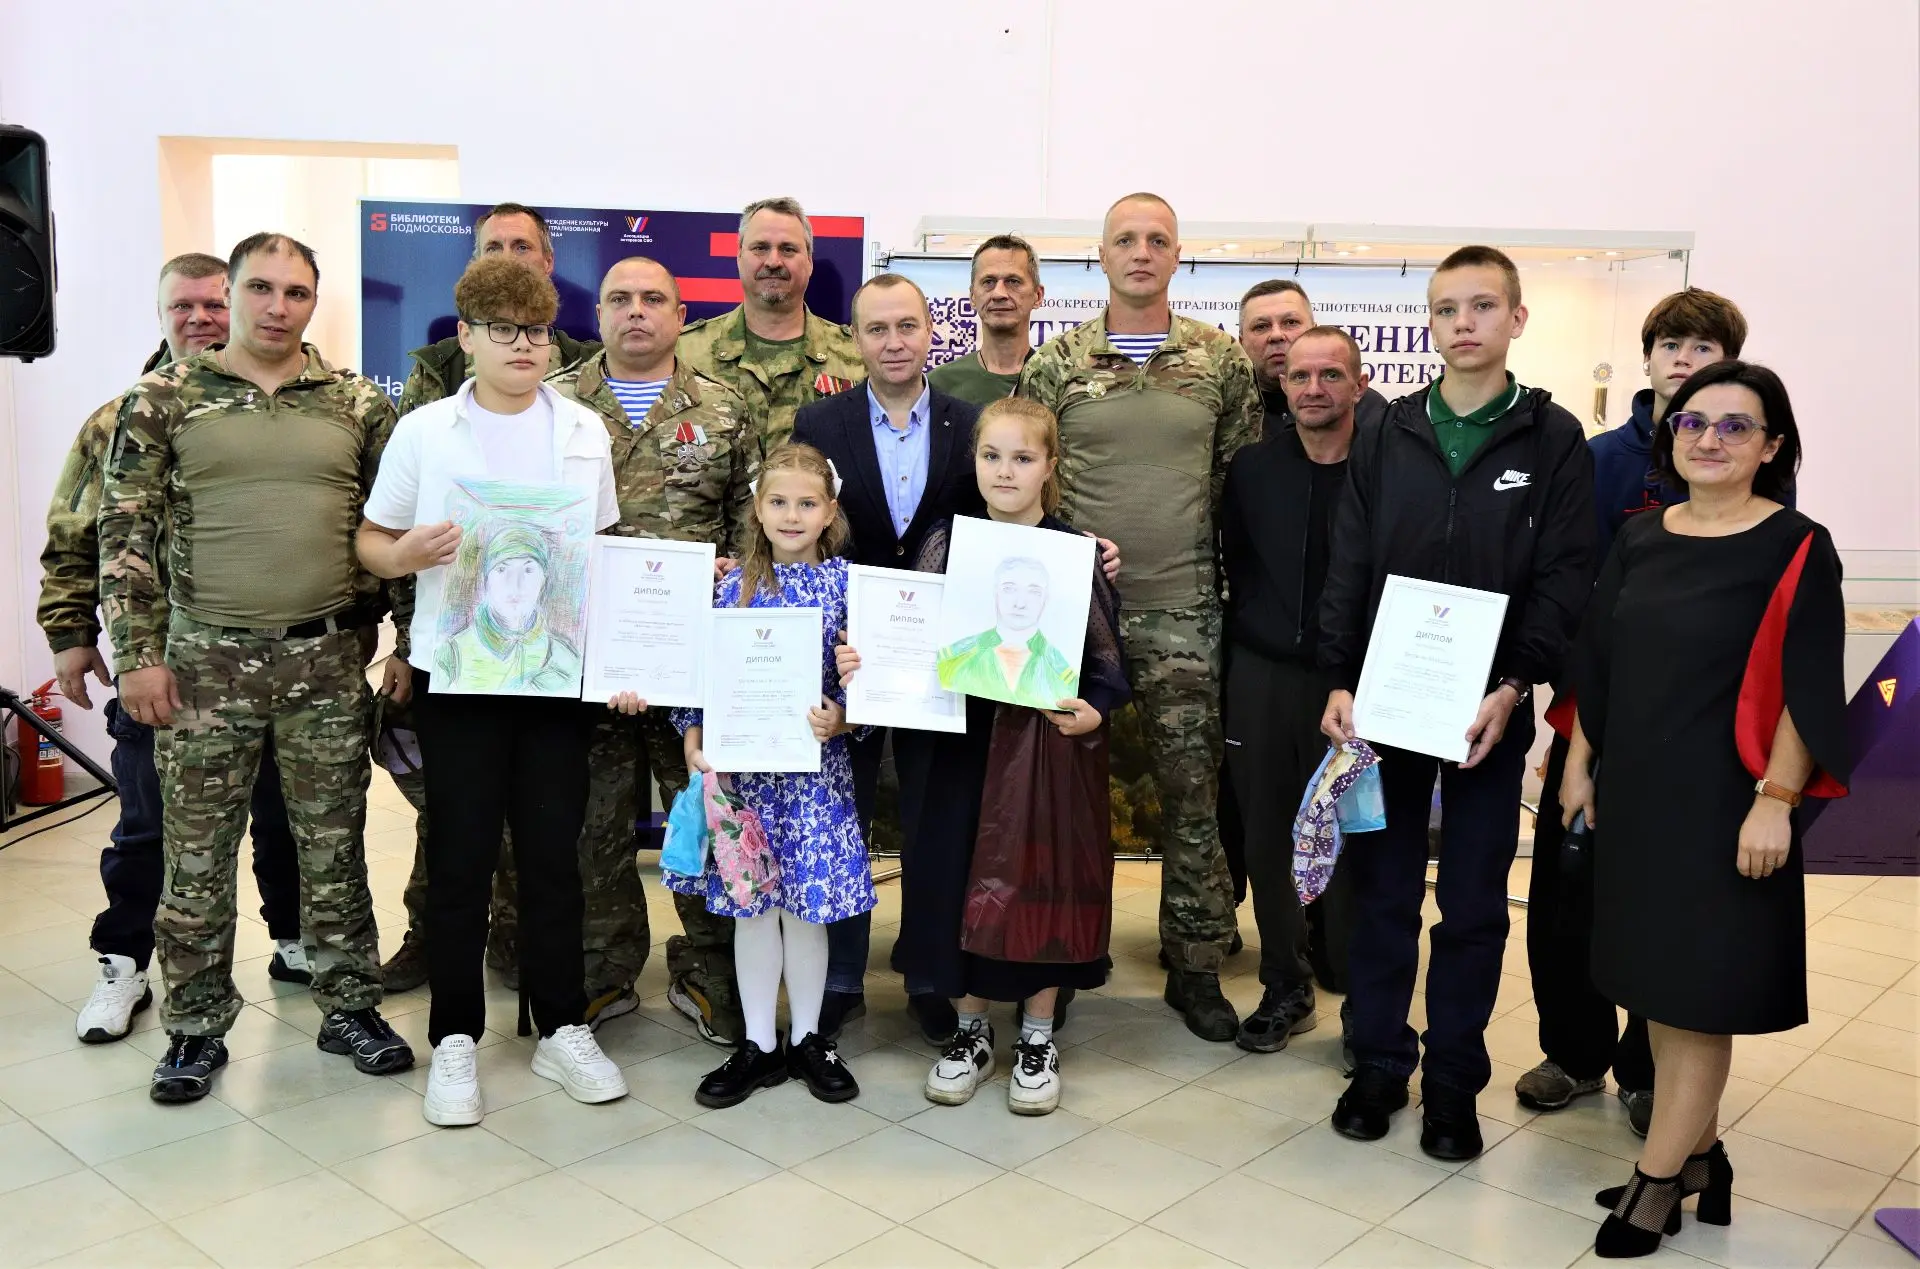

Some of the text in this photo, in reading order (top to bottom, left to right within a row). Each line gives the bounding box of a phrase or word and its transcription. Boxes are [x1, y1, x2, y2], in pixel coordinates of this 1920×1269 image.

[390, 214, 460, 224] БИБЛИОТЕКИ
[390, 224, 472, 234] ПОДМОСКОВЬЯ
[1500, 469, 1530, 483] NIKE
[633, 587, 671, 596] ДИПЛОМ
[889, 614, 925, 625] ДИПЛОМ
[1415, 630, 1453, 643] ДИПЛОМ
[745, 656, 782, 664] ДИПЛОМ
